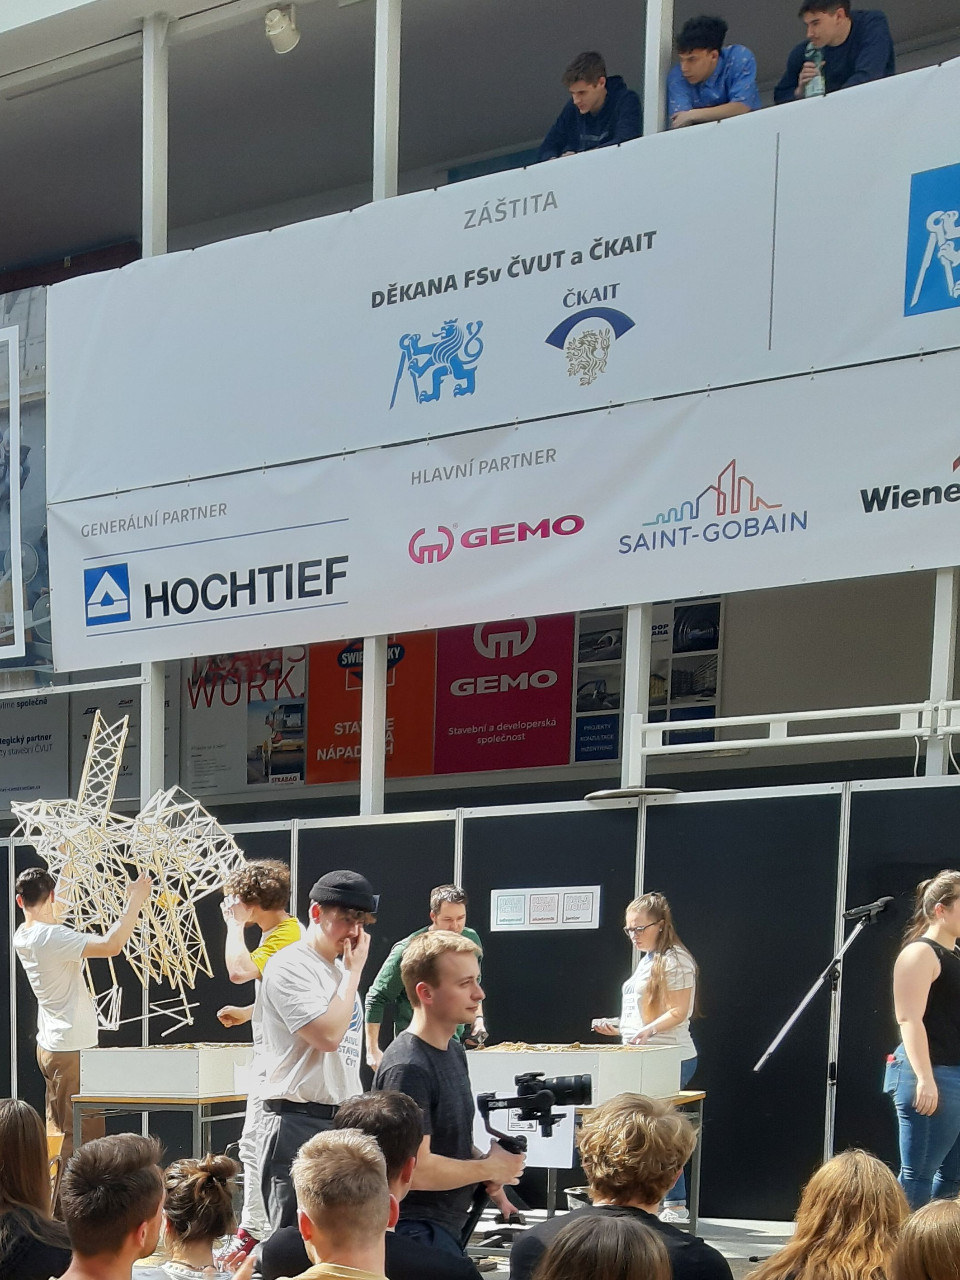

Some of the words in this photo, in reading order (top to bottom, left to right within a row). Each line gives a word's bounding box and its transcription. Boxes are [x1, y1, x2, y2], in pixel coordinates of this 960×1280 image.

[464, 190, 558, 229] ZÁŠTITA
[371, 274, 458, 308] DĚKANA
[464, 267, 502, 288] FSv
[507, 250, 566, 278] ČVUT
[570, 250, 583, 265] a
[589, 230, 657, 261] ČKAIT
[562, 282, 621, 308] ČKAIT
[411, 458, 474, 485] HLAVNÍ
[478, 448, 557, 475] PARTNER
[80, 510, 159, 538] GENERÁLNÍ
[162, 502, 227, 525] PARTNER
[460, 514, 585, 549] GEMO
[618, 510, 808, 554] SAINT-GOBAIN
[144, 555, 349, 619] HOCHTIEF
[341, 646, 401, 665] SWIEKY
[450, 669, 558, 697] GEMO
[27, 734, 52, 745] partner
[448, 722, 487, 736] Stavební
[496, 718, 557, 733] developerská
[477, 733, 525, 745] společnost
[316, 742, 394, 762] NÁPADH
